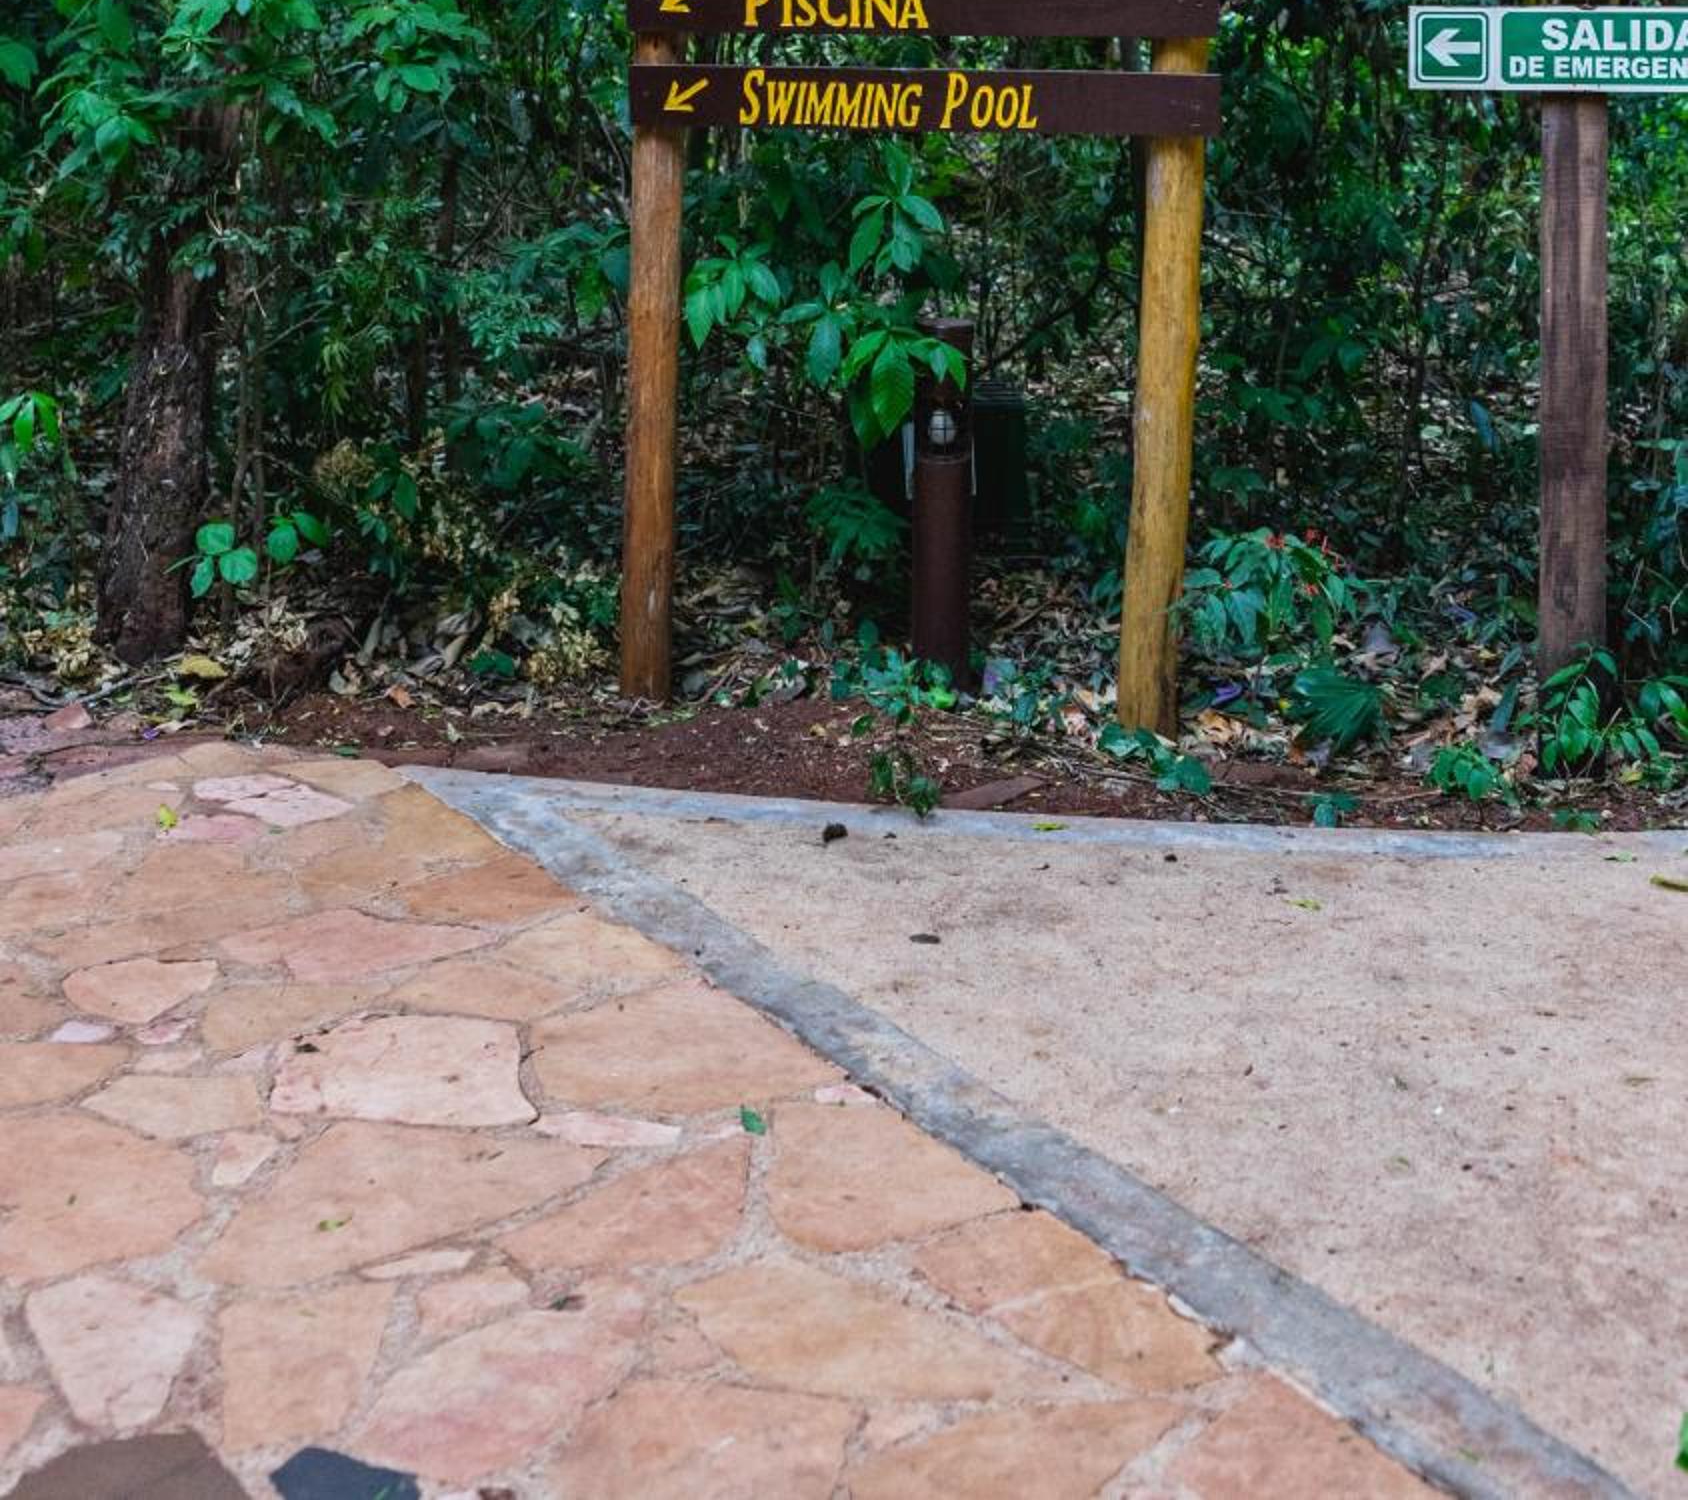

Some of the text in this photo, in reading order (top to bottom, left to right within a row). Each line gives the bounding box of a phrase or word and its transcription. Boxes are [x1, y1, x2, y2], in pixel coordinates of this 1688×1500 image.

[1509, 56, 1544, 78] DE
[739, 69, 1037, 129] SWIMMING POOL
